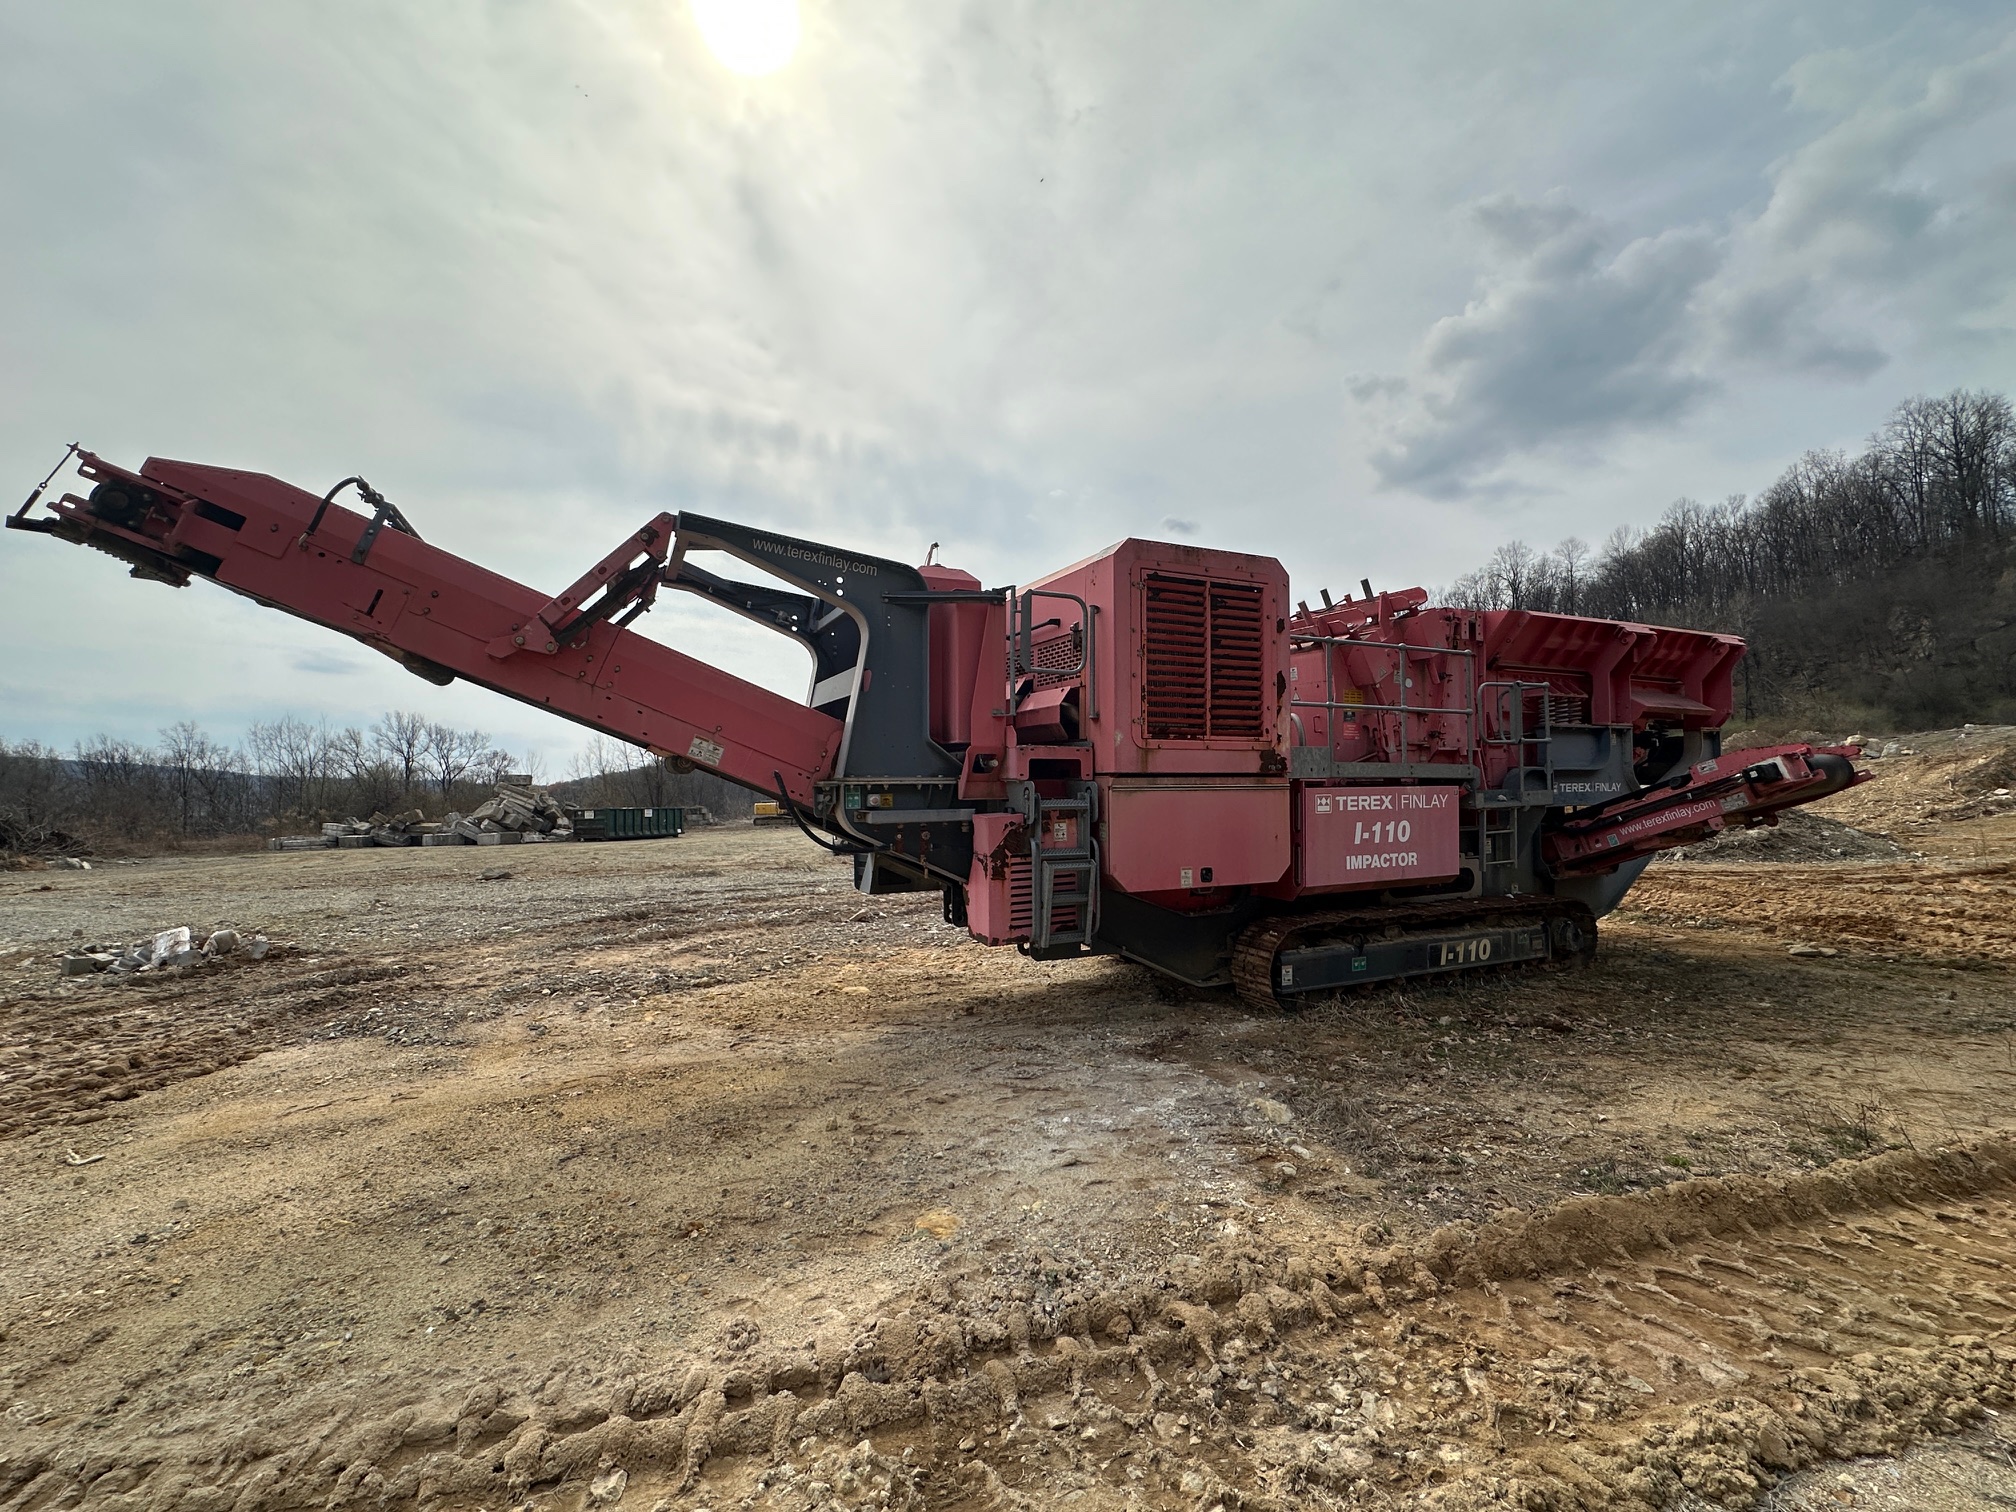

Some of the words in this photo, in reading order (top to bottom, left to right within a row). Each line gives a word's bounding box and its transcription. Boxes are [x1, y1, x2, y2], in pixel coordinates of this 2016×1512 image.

[753, 539, 878, 576] www.terexfinlay.com
[1559, 783, 1591, 793] TEREX
[1594, 782, 1622, 792] FINLAY
[1335, 795, 1393, 811] TEREX
[1401, 794, 1448, 809] FINLAY
[1619, 799, 1716, 836] www.terexfinlay.com
[1354, 820, 1411, 845] I-110
[1346, 852, 1418, 870] IMPACTOR
[1440, 938, 1491, 966] I-110
